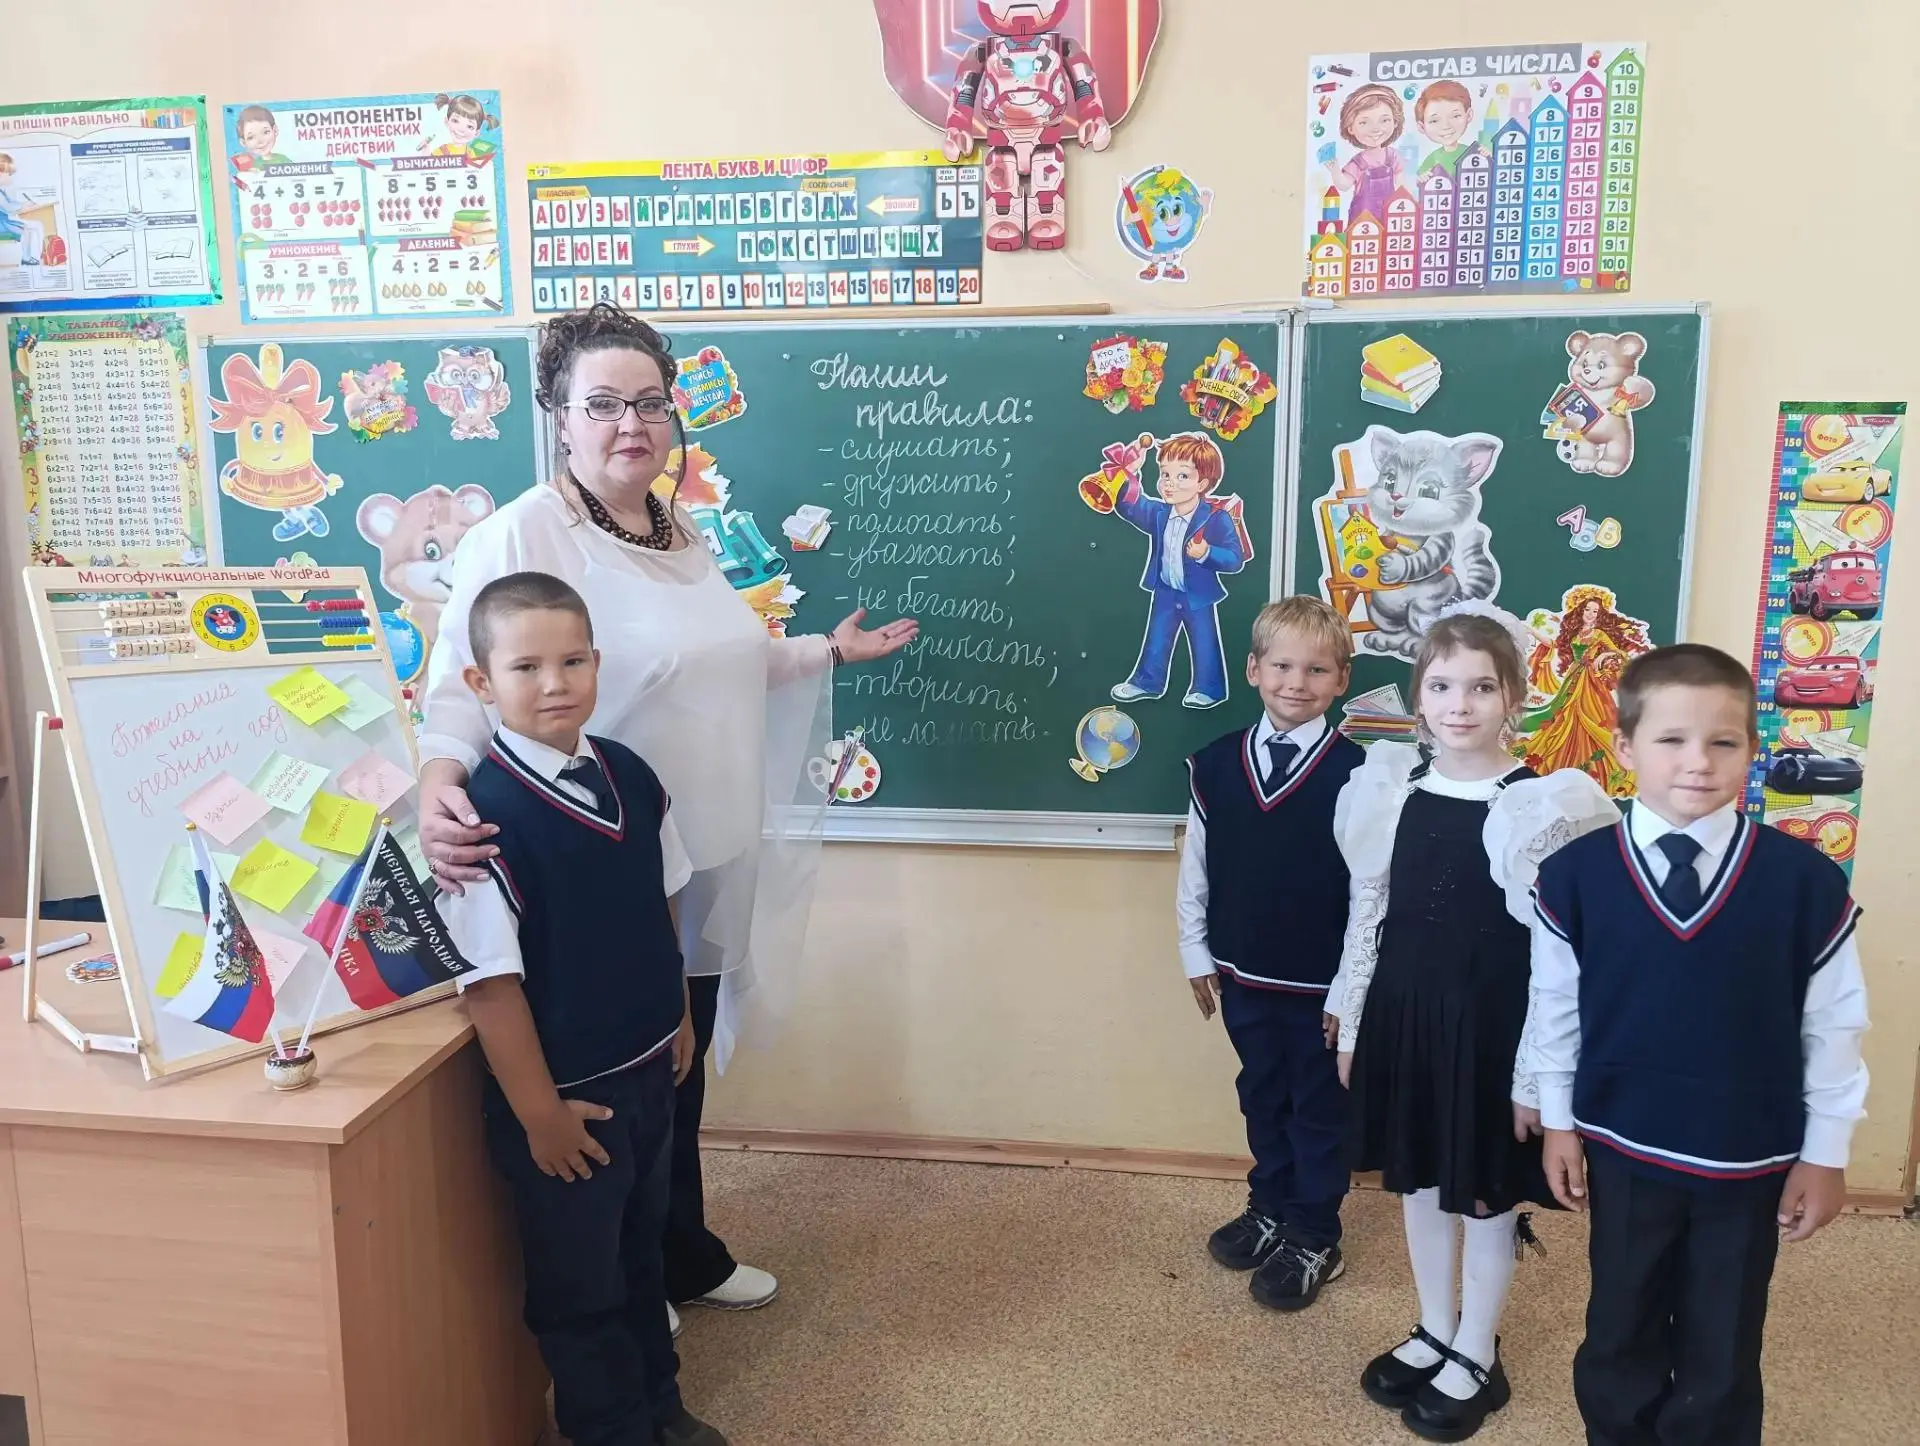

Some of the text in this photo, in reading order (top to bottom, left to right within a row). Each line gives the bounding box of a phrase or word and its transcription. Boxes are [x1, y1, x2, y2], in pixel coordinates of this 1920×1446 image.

[1377, 53, 1575, 79] СОСТАВ ЧИСЛА
[1620, 64, 1633, 74] 10
[1584, 87, 1593, 97] 9
[2, 113, 129, 130] И ПИШИ ПРАВИЛЬНО
[295, 107, 422, 127] КОМПОНЕНТЫ
[1547, 111, 1554, 121] 8
[298, 123, 420, 140] МАТЕМАТИЧЕСКИХ
[1510, 134, 1517, 144] 7
[326, 140, 395, 157] ДЕЙСТВИЙ
[397, 158, 462, 169] ВЫЧИТАНИЕ
[1472, 157, 1479, 167] 6
[270, 164, 328, 175] СЛОЖЕНИЕ
[662, 158, 828, 178] ЛЕНТА БУКВ И ЦИФР
[388, 179, 399, 193] 8
[426, 177, 437, 192] 5
[467, 175, 477, 190] 3
[808, 181, 848, 189] СОГЛАСНЫЕ
[1435, 179, 1443, 189] 5
[254, 185, 265, 199] 4
[294, 184, 305, 199] 3
[334, 181, 344, 196] 7
[546, 189, 575, 197] ГЛАСНЫЕ
[884, 200, 917, 209] ЗВОНКИЕ
[1396, 201, 1405, 211] 4
[1362, 224, 1369, 234] 3
[407, 238, 455, 250] ДЕЛЕНИЕ
[673, 242, 700, 251] ГЛУХИЕ
[271, 245, 337, 256] УМНОЖЕНИЕ
[1326, 246, 1333, 256] 2
[264, 264, 274, 279] 3
[298, 263, 308, 277] 2
[338, 261, 348, 276] 6
[392, 259, 404, 274] 4
[428, 258, 439, 272] 2
[469, 256, 479, 271] 2
[539, 287, 548, 302] 0
[561, 286, 567, 301] 1
[580, 285, 588, 300] 2
[622, 285, 631, 300] 4
[644, 284, 652, 300] 5
[664, 284, 673, 300] 6
[684, 284, 694, 299] 7
[706, 283, 715, 299] 8
[727, 283, 736, 299] 9
[744, 283, 760, 298] 10
[767, 282, 781, 298] 11
[787, 281, 804, 297] 12
[808, 280, 825, 296] 13
[830, 280, 846, 296] 14
[851, 279, 866, 294] 15
[872, 278, 888, 294] 16
[895, 278, 911, 294] 17
[917, 278, 932, 294] 18
[938, 277, 954, 293] 19
[960, 277, 978, 293] 20
[810, 352, 948, 389] Наши
[685, 377, 726, 398] СТРЕМИСЬ!
[692, 389, 725, 408] МЕЧТАЙ!
[857, 390, 1033, 439] правила:
[1784, 437, 1801, 447] 150
[1817, 434, 1838, 444] ФОТО
[1779, 492, 1796, 501] 140
[1852, 510, 1871, 525] ФОТО
[1773, 546, 1790, 555] 130
[77, 568, 330, 585] Многофункциональные WordPad
[858, 585, 887, 610] не
[1767, 599, 1785, 607] 120
[1763, 650, 1779, 660] 110
[1757, 702, 1774, 712] 100
[1792, 716, 1814, 724] ФОТО
[414, 908, 463, 973] НАРОДНАЯ
